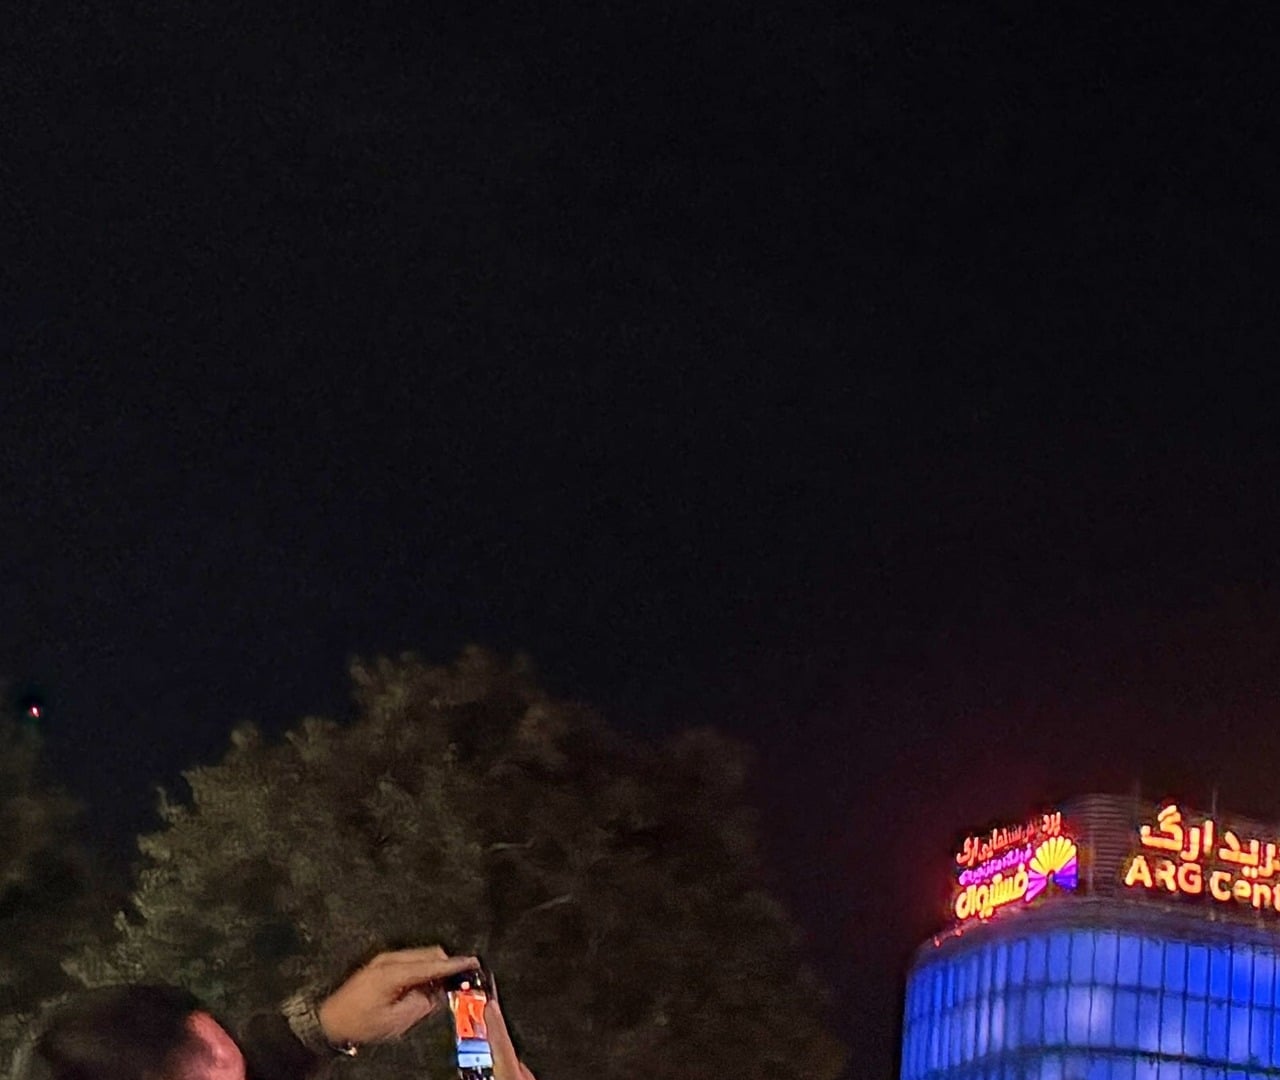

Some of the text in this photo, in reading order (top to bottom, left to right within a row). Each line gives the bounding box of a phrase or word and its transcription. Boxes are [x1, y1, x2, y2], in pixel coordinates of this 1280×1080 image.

[956, 836, 980, 867] ارگ
[1139, 804, 1214, 862] ارگ
[955, 862, 1029, 920] فستیوال
[1124, 854, 1203, 895] ARG
